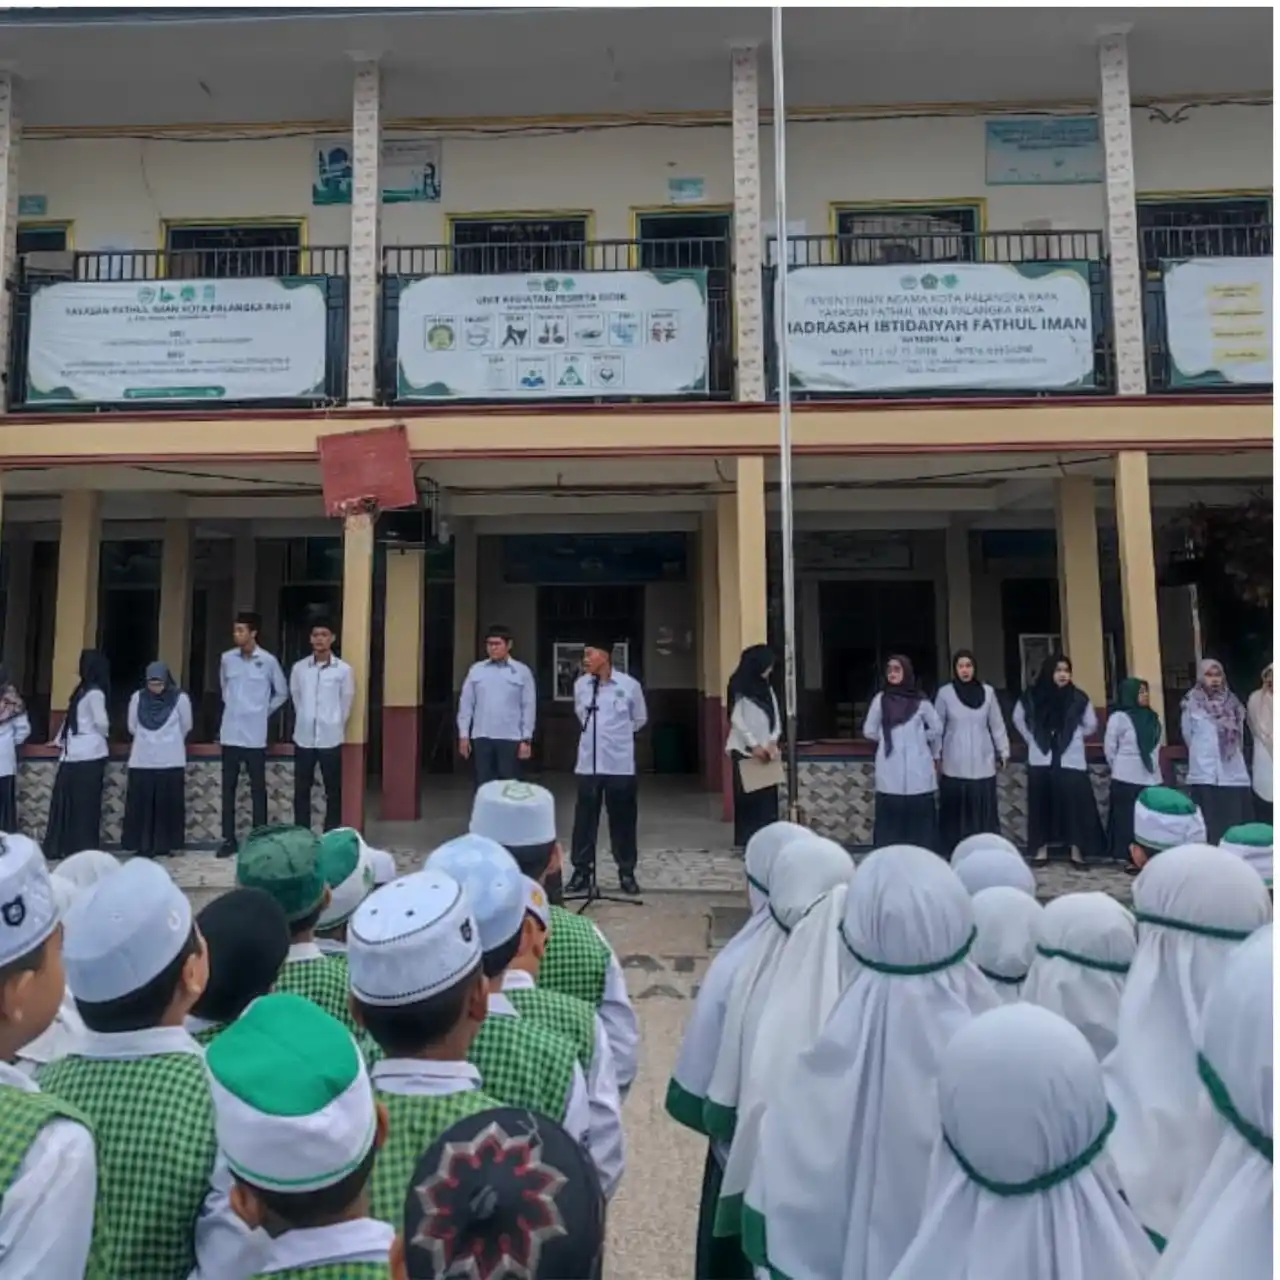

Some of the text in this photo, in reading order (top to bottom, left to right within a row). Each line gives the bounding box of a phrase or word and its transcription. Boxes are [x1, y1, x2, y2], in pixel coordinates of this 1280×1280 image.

[787, 317, 1087, 334] ADRASAH IBTIDAIYAH FATHUL IMAN
